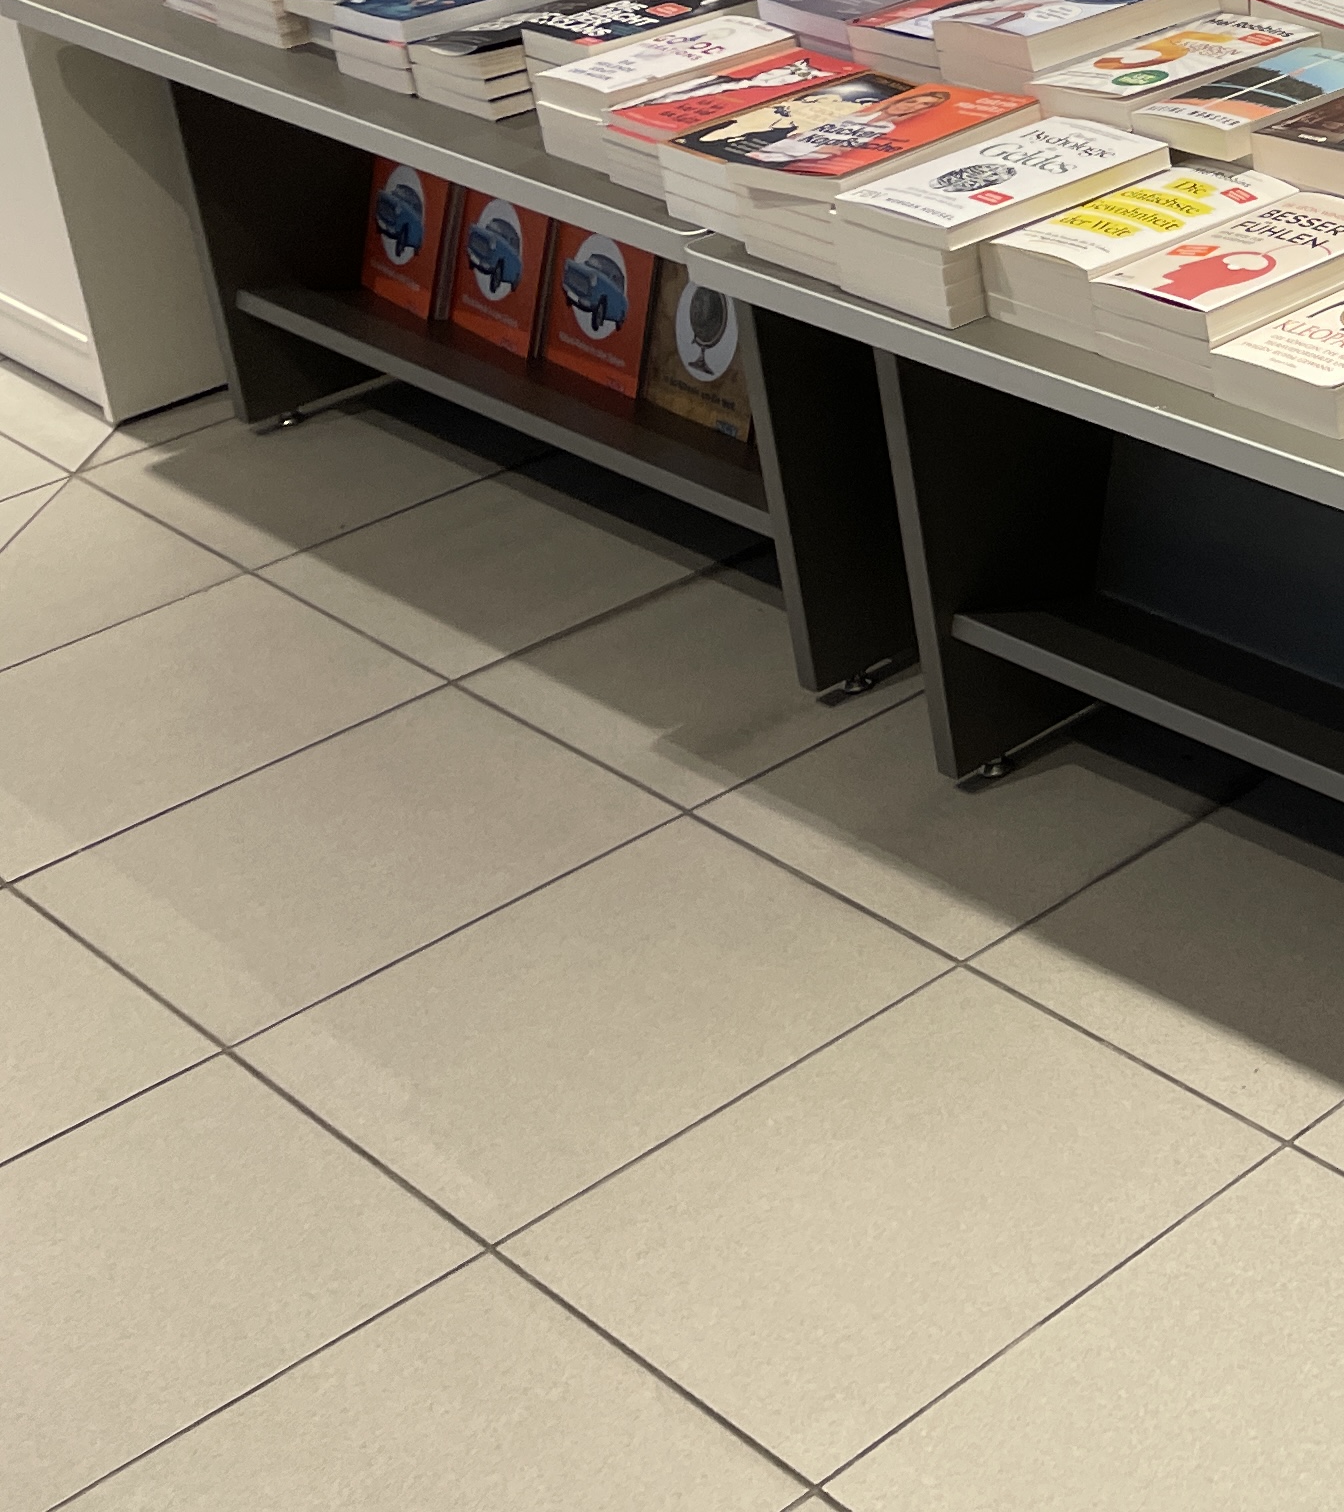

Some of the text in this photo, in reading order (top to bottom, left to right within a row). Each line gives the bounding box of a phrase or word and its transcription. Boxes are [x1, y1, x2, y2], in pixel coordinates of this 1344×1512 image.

[1174, 180, 1207, 196] Die
[1091, 216, 1132, 237] Welt
[1231, 219, 1329, 250] FÜHLEN
